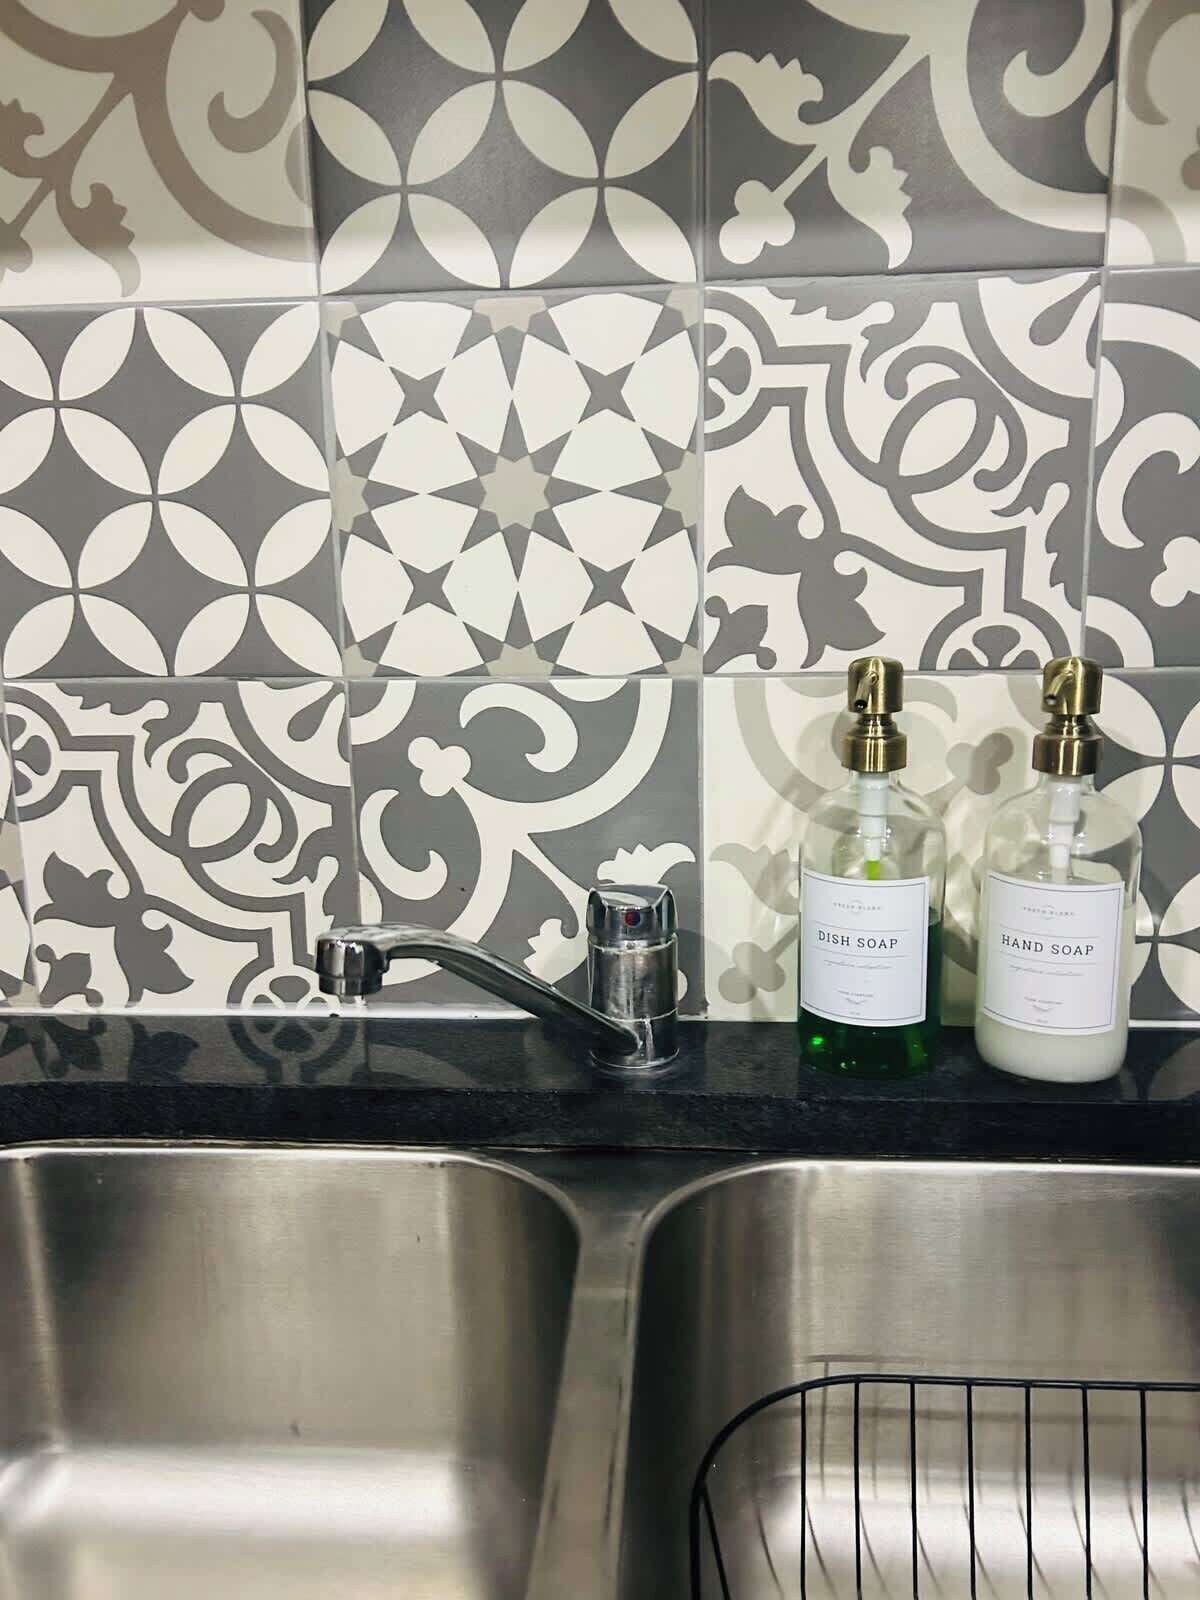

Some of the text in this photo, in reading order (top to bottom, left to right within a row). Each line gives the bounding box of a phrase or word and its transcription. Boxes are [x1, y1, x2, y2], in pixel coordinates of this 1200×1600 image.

[818, 930, 899, 950] DISH SOAP
[1001, 934, 1095, 956] HAND SOAP
